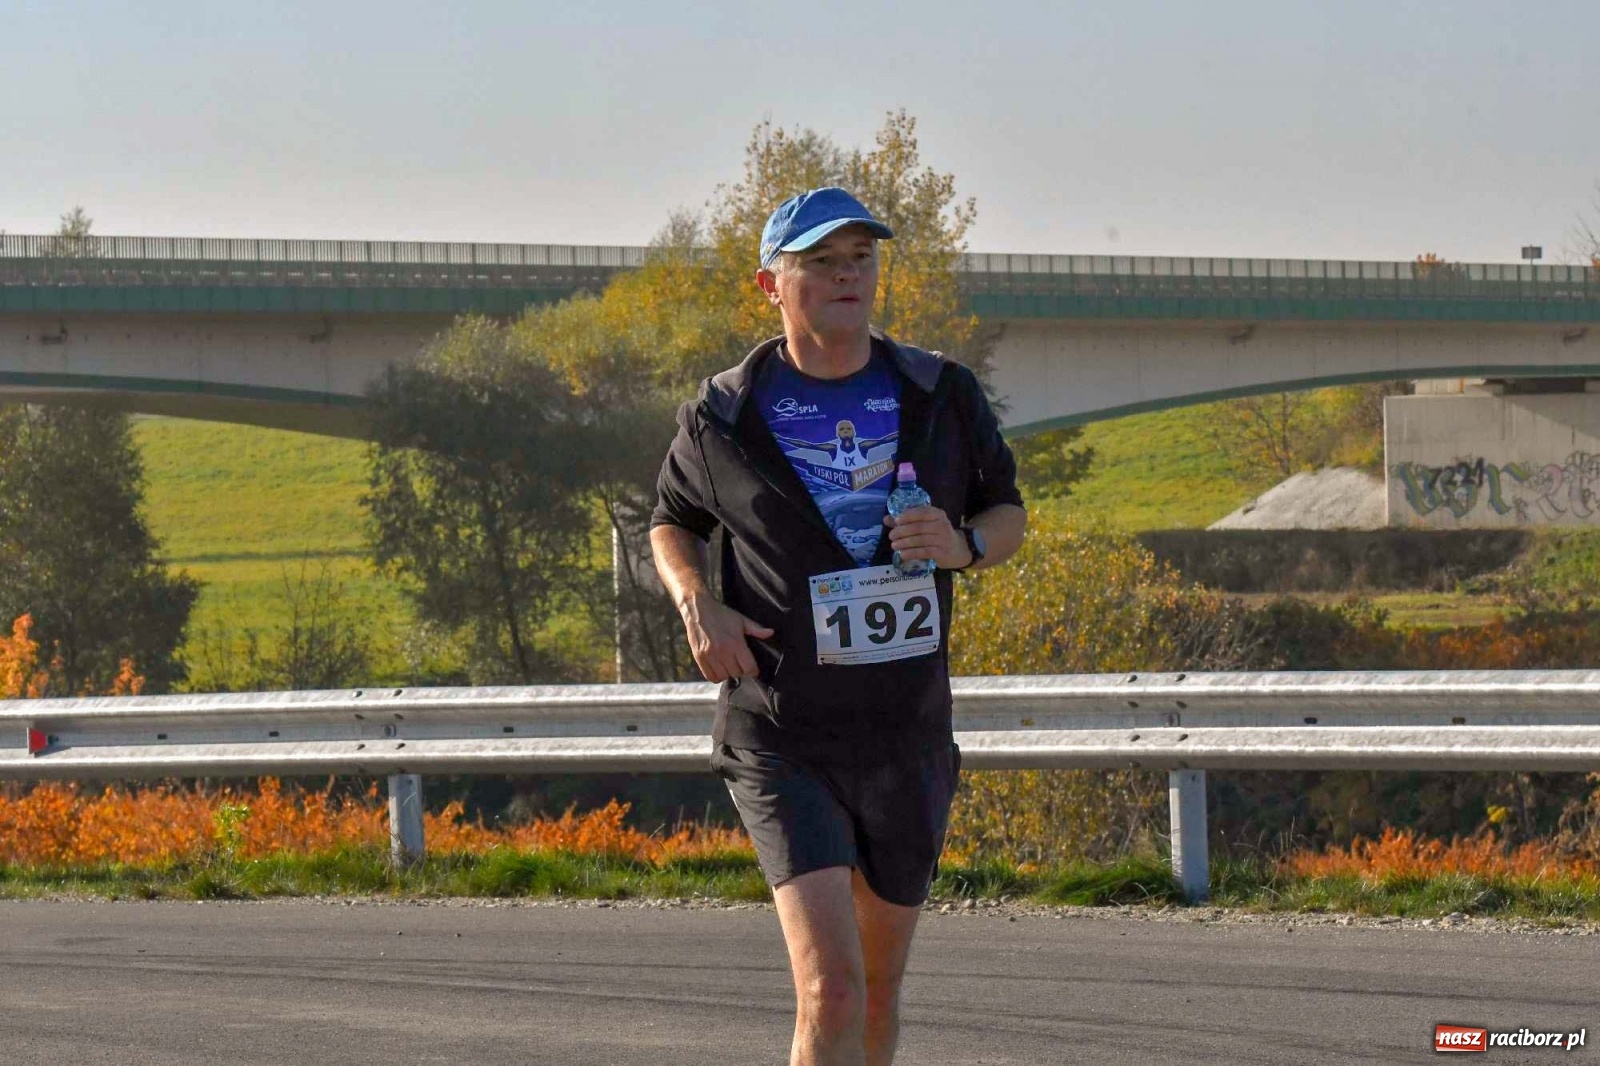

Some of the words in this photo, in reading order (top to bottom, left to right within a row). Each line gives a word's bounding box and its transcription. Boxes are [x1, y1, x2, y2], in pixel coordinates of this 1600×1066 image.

[798, 404, 819, 413] SPLA
[844, 456, 856, 467] IX
[826, 596, 933, 648] 192
